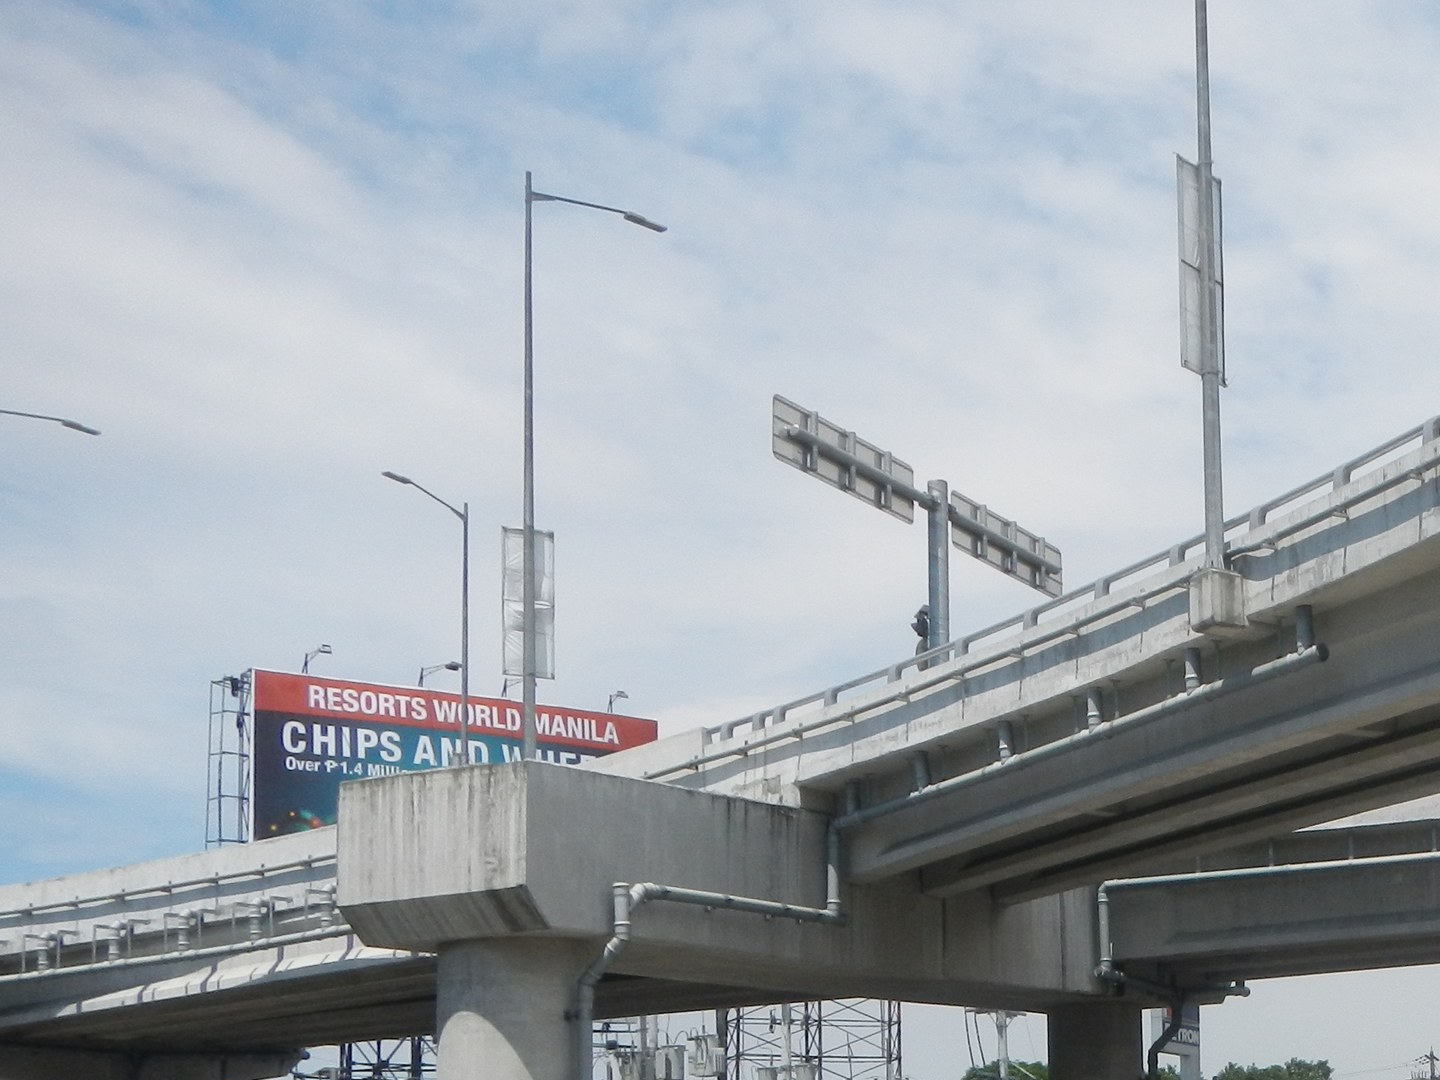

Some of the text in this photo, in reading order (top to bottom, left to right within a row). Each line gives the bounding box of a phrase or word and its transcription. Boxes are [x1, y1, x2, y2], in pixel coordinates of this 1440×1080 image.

[308, 684, 620, 745] RESORTS WORLD MANILA
[282, 719, 402, 763] CHIPS
[413, 734, 489, 768] AND
[285, 756, 321, 772] Over
